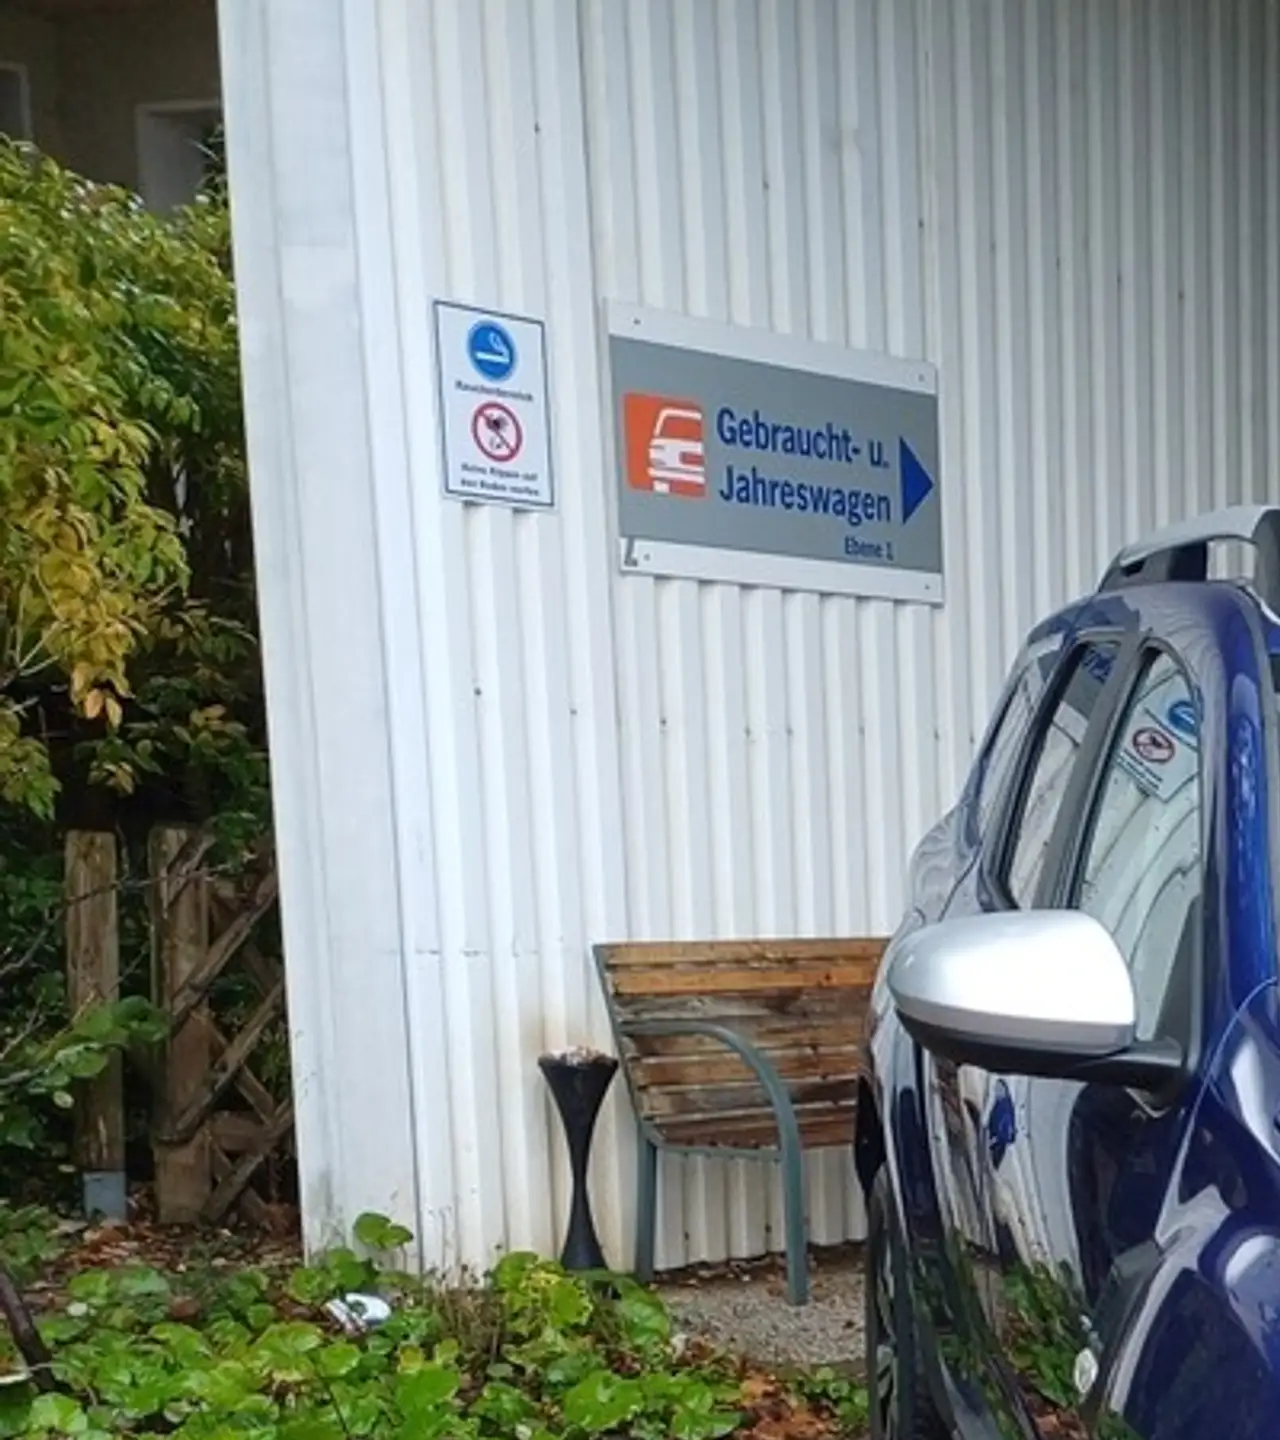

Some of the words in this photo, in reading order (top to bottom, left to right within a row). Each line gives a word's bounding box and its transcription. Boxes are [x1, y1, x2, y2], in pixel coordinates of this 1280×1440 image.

[716, 406, 862, 465] Gebraucht-
[868, 442, 890, 469] u.
[719, 465, 892, 524] Jahreswagen
[844, 535, 883, 560] Ebene
[885, 541, 894, 561] 1
